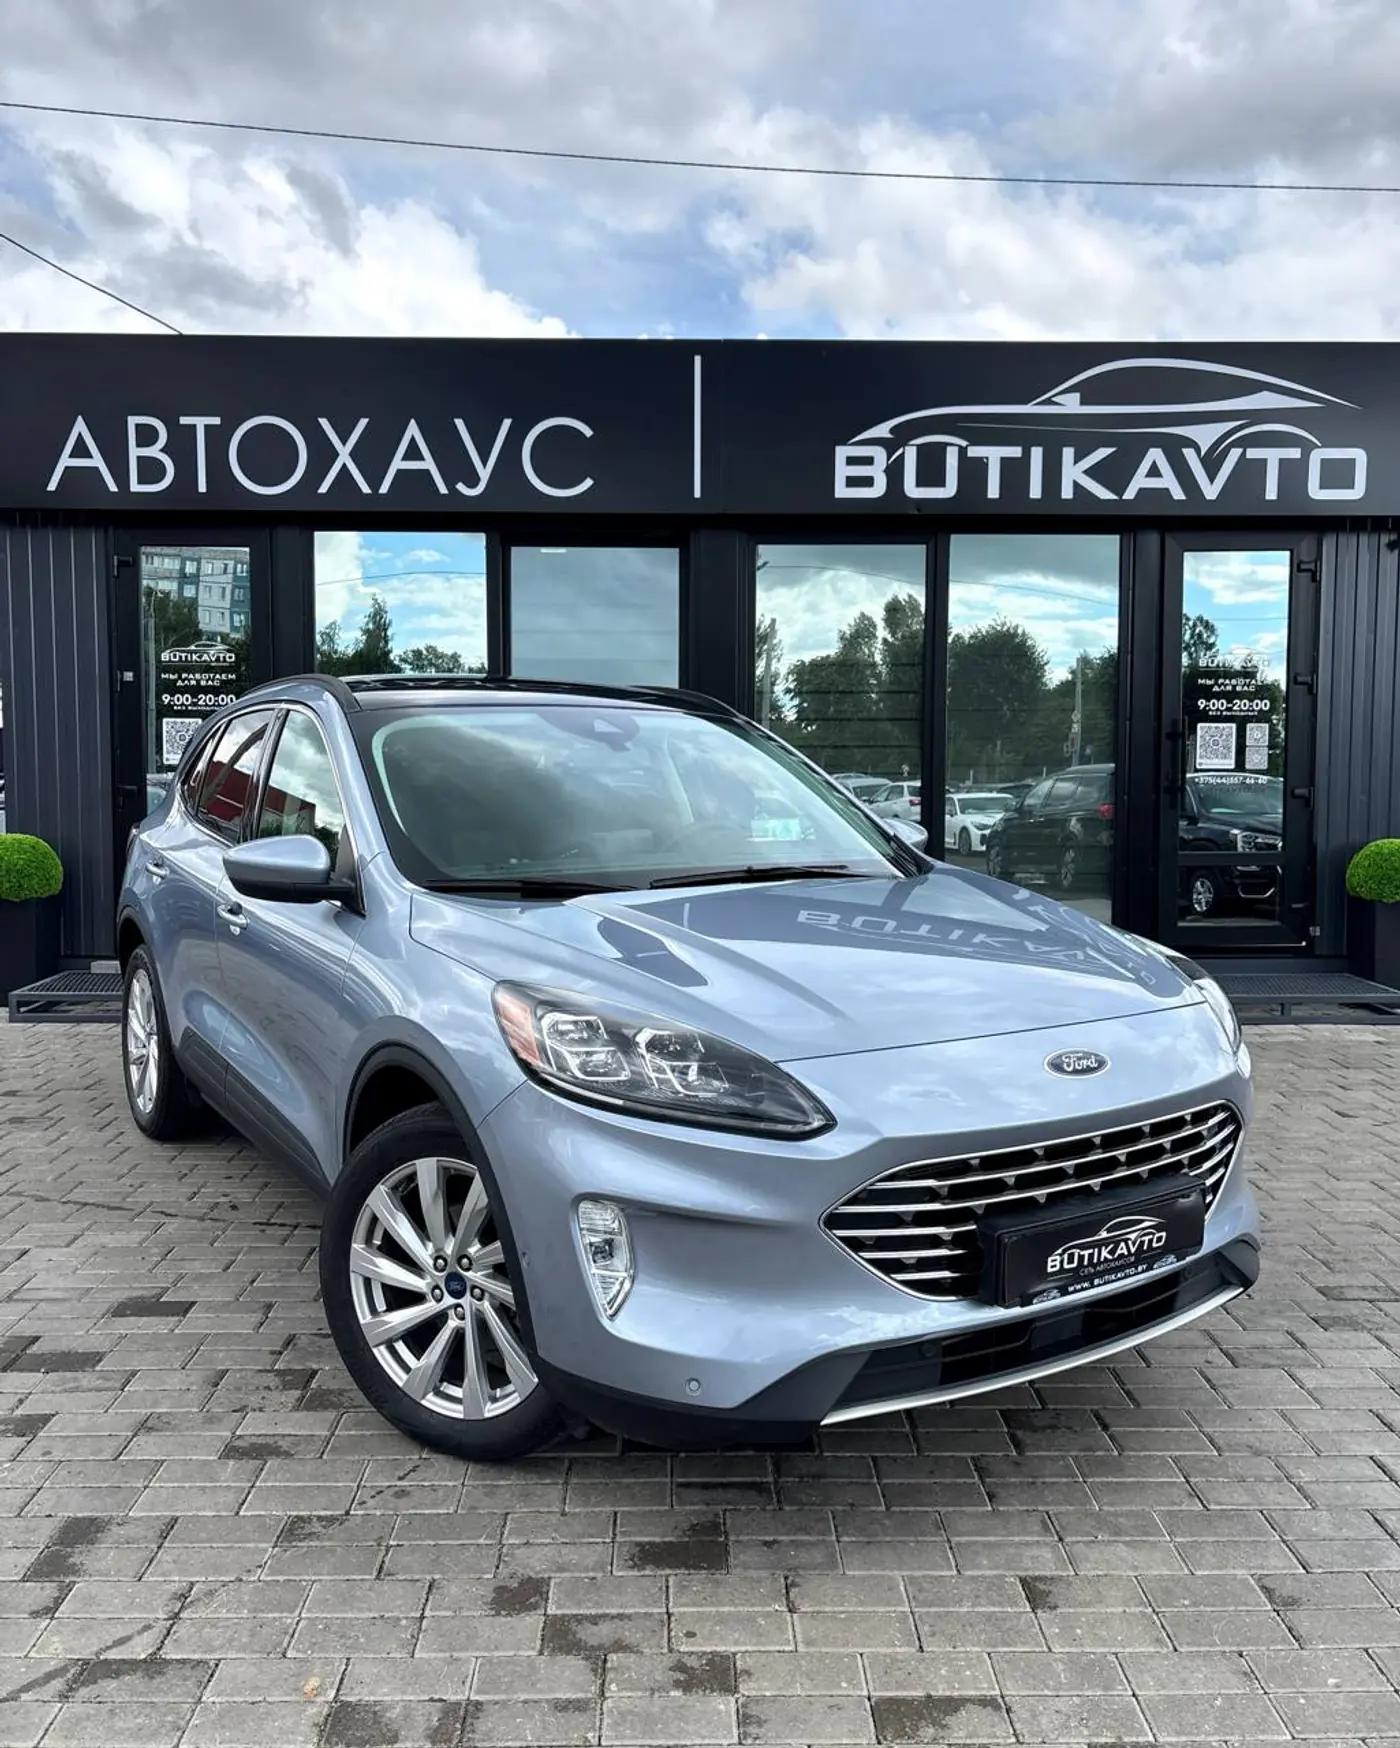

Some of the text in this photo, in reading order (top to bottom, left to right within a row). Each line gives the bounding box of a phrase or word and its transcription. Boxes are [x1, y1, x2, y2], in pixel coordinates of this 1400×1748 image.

[46, 415, 594, 497] АВТОХАУС
[834, 445, 1368, 501] BUTIKAVTO
[161, 652, 236, 662] BUTIKAVTO
[162, 694, 236, 705] 9:00-20:00
[1197, 699, 1270, 711] 9:00-20:00
[1062, 1053, 1099, 1071] Ford
[1047, 1232, 1167, 1273] BUTIKAVTO
